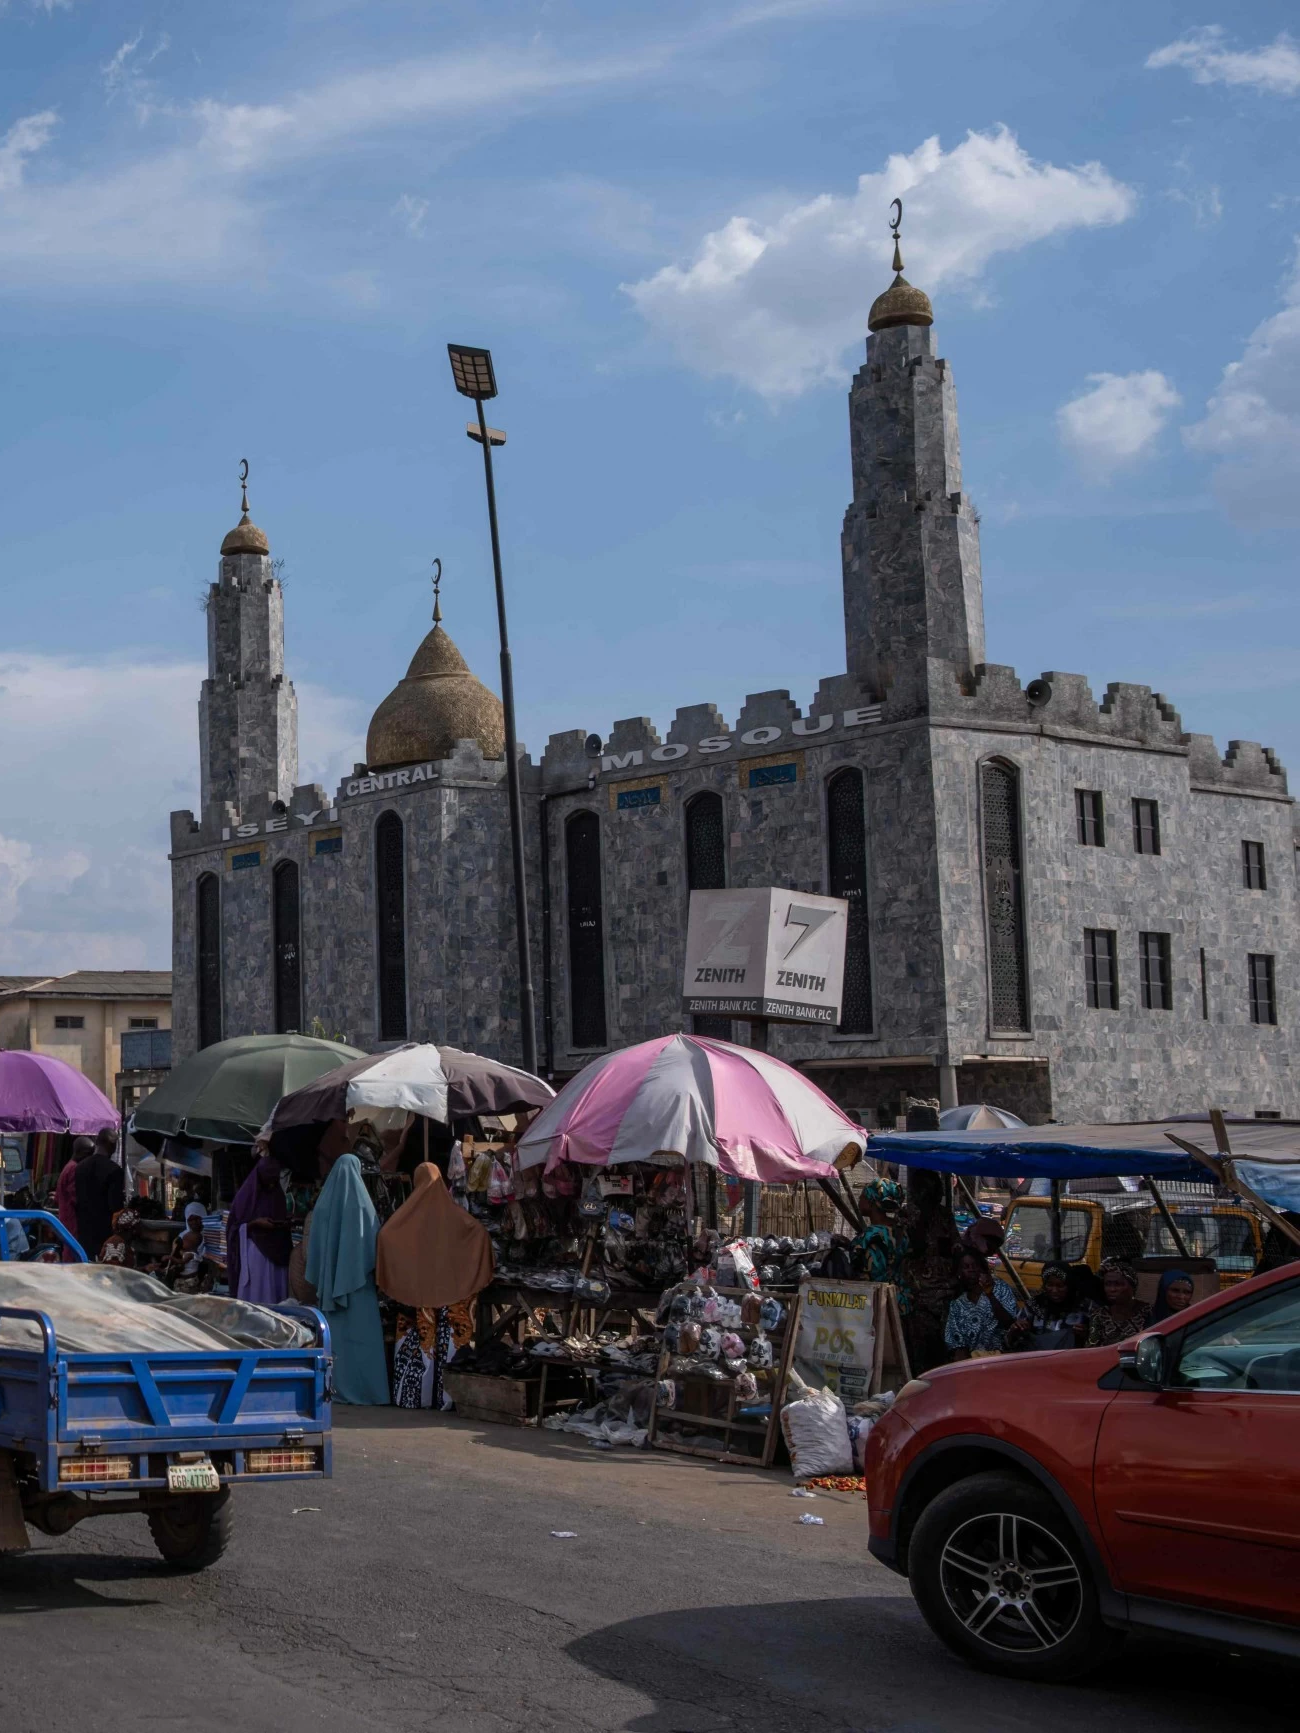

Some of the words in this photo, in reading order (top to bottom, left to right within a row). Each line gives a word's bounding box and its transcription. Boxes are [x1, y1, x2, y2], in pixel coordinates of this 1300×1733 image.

[601, 704, 883, 773] MOSQUE
[346, 764, 439, 798] CENTRAL
[694, 967, 746, 984] ZENITH
[775, 970, 826, 992] ZENITH
[689, 1000, 718, 1011] ZENITH
[719, 1000, 741, 1011] BANK
[742, 1001, 757, 1012] PLC
[766, 1002, 795, 1016] ZENITH
[795, 1007, 818, 1019] BANK
[818, 1009, 832, 1021] PLC
[807, 1290, 868, 1311] FUNMILAT
[812, 1326, 856, 1355] POS
